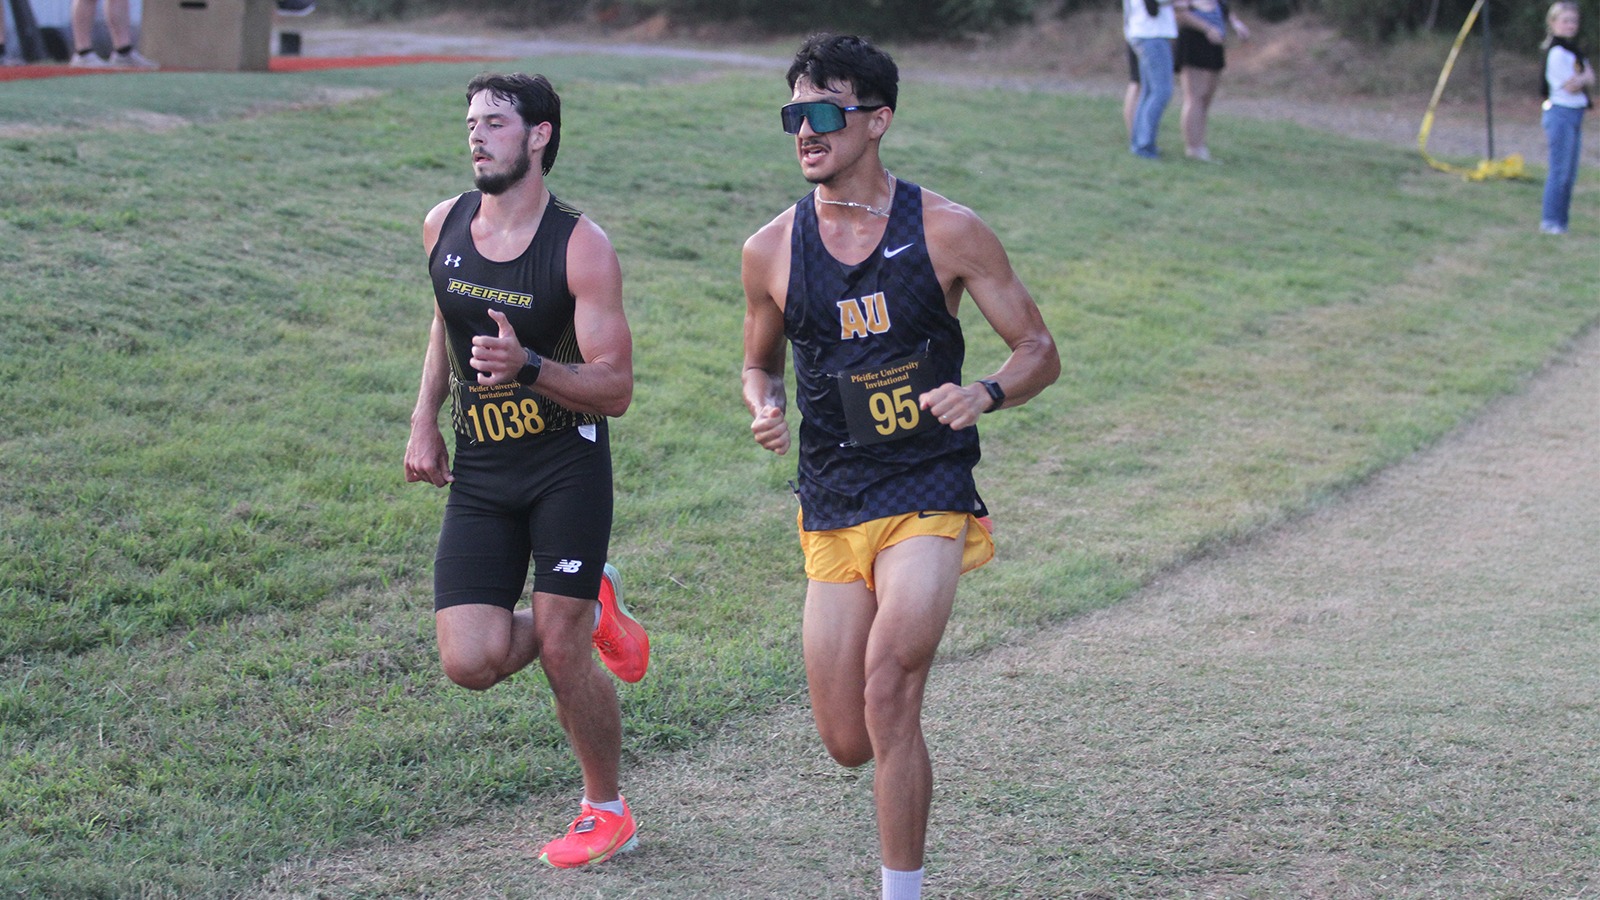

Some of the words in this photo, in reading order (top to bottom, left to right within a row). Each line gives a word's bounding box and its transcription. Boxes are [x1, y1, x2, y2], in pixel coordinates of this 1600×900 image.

[447, 278, 534, 309] PFEIFFER
[836, 291, 891, 340] AU
[851, 372, 879, 383] Pfeiffer
[880, 361, 919, 377] University
[865, 372, 909, 390] Invitational
[478, 389, 515, 400] Invitational
[467, 398, 545, 442] 1038
[868, 385, 920, 436] 95
